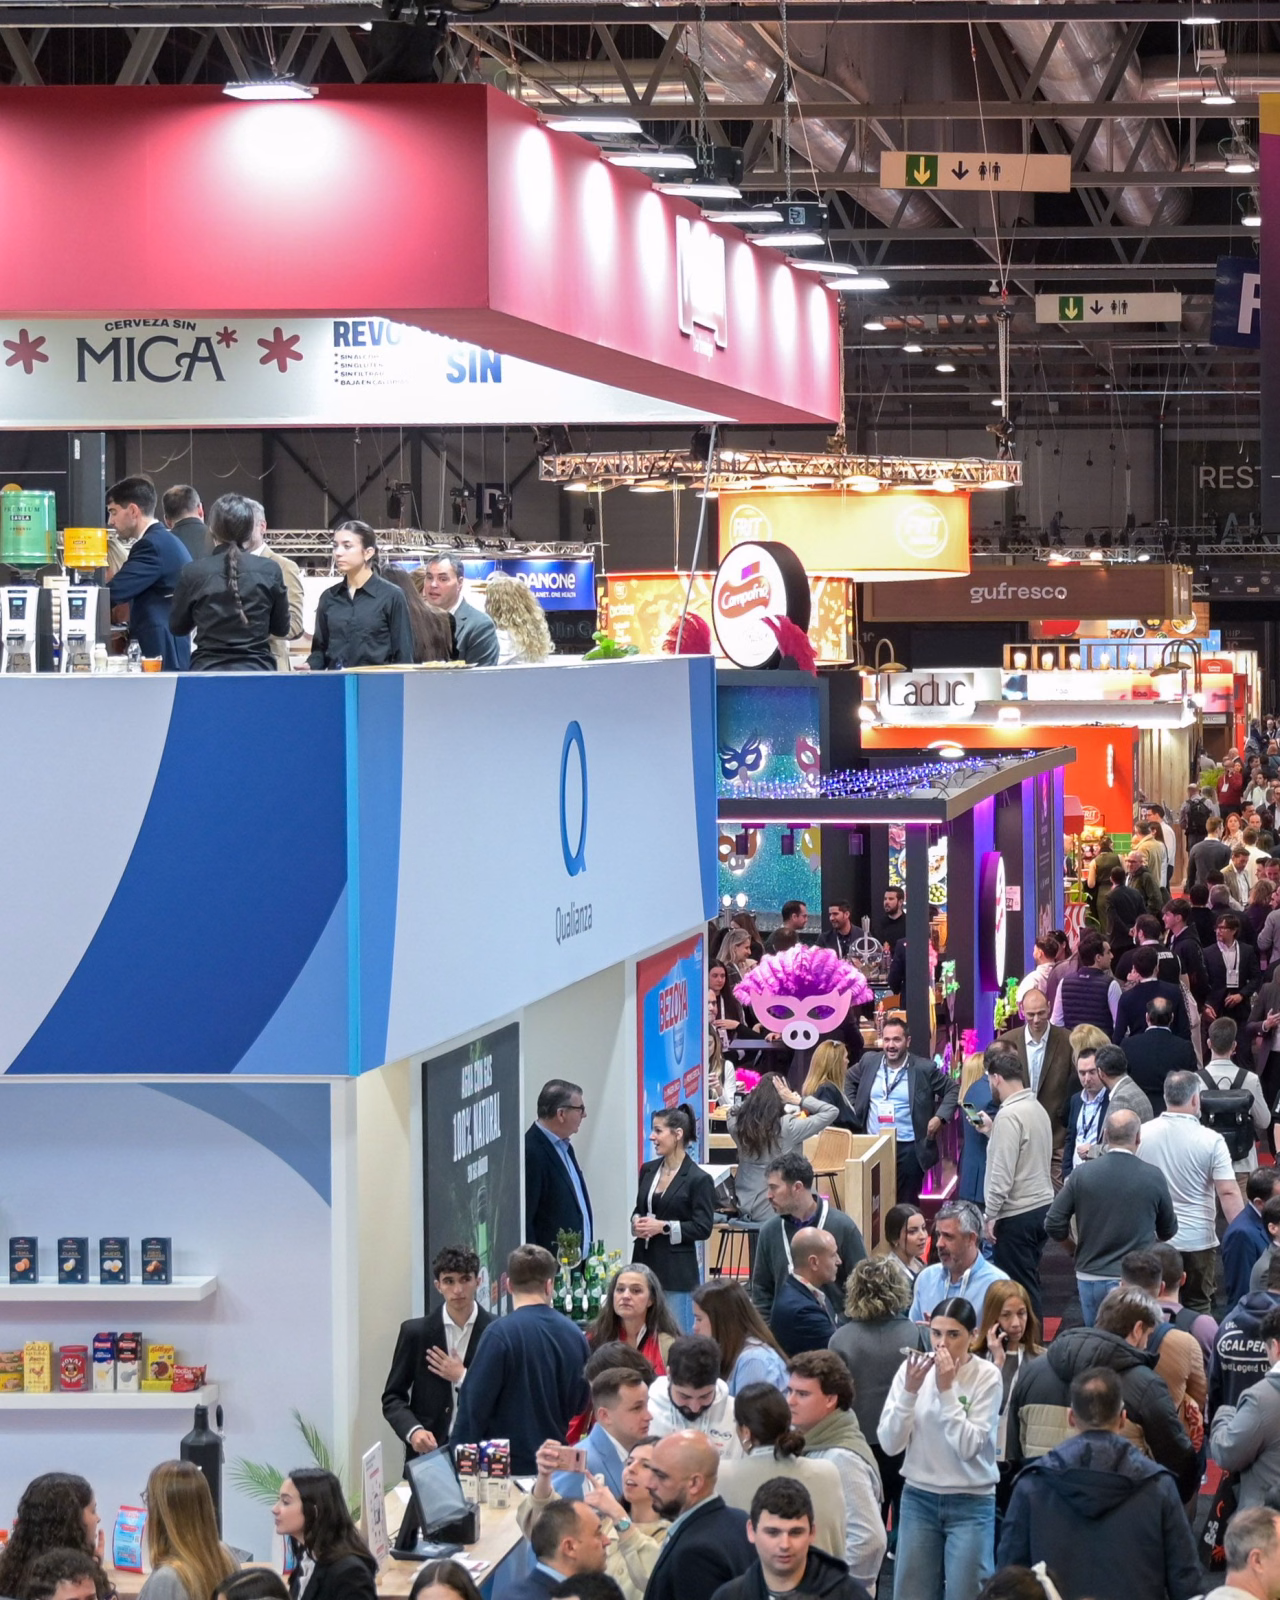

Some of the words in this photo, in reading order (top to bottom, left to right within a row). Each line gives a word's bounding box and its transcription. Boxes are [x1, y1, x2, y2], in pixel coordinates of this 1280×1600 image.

[104, 318, 170, 332] CERVEZA
[172, 319, 197, 332] SIN
[76, 335, 226, 383] MICA
[446, 350, 502, 384] SIN
[970, 582, 1067, 603] gufresco
[888, 673, 966, 706] Laduc
[555, 901, 593, 946] Qualianza
[659, 977, 689, 1035] BEZOYA
[453, 1106, 472, 1163] 100%
[473, 1091, 501, 1151] NATURAL
